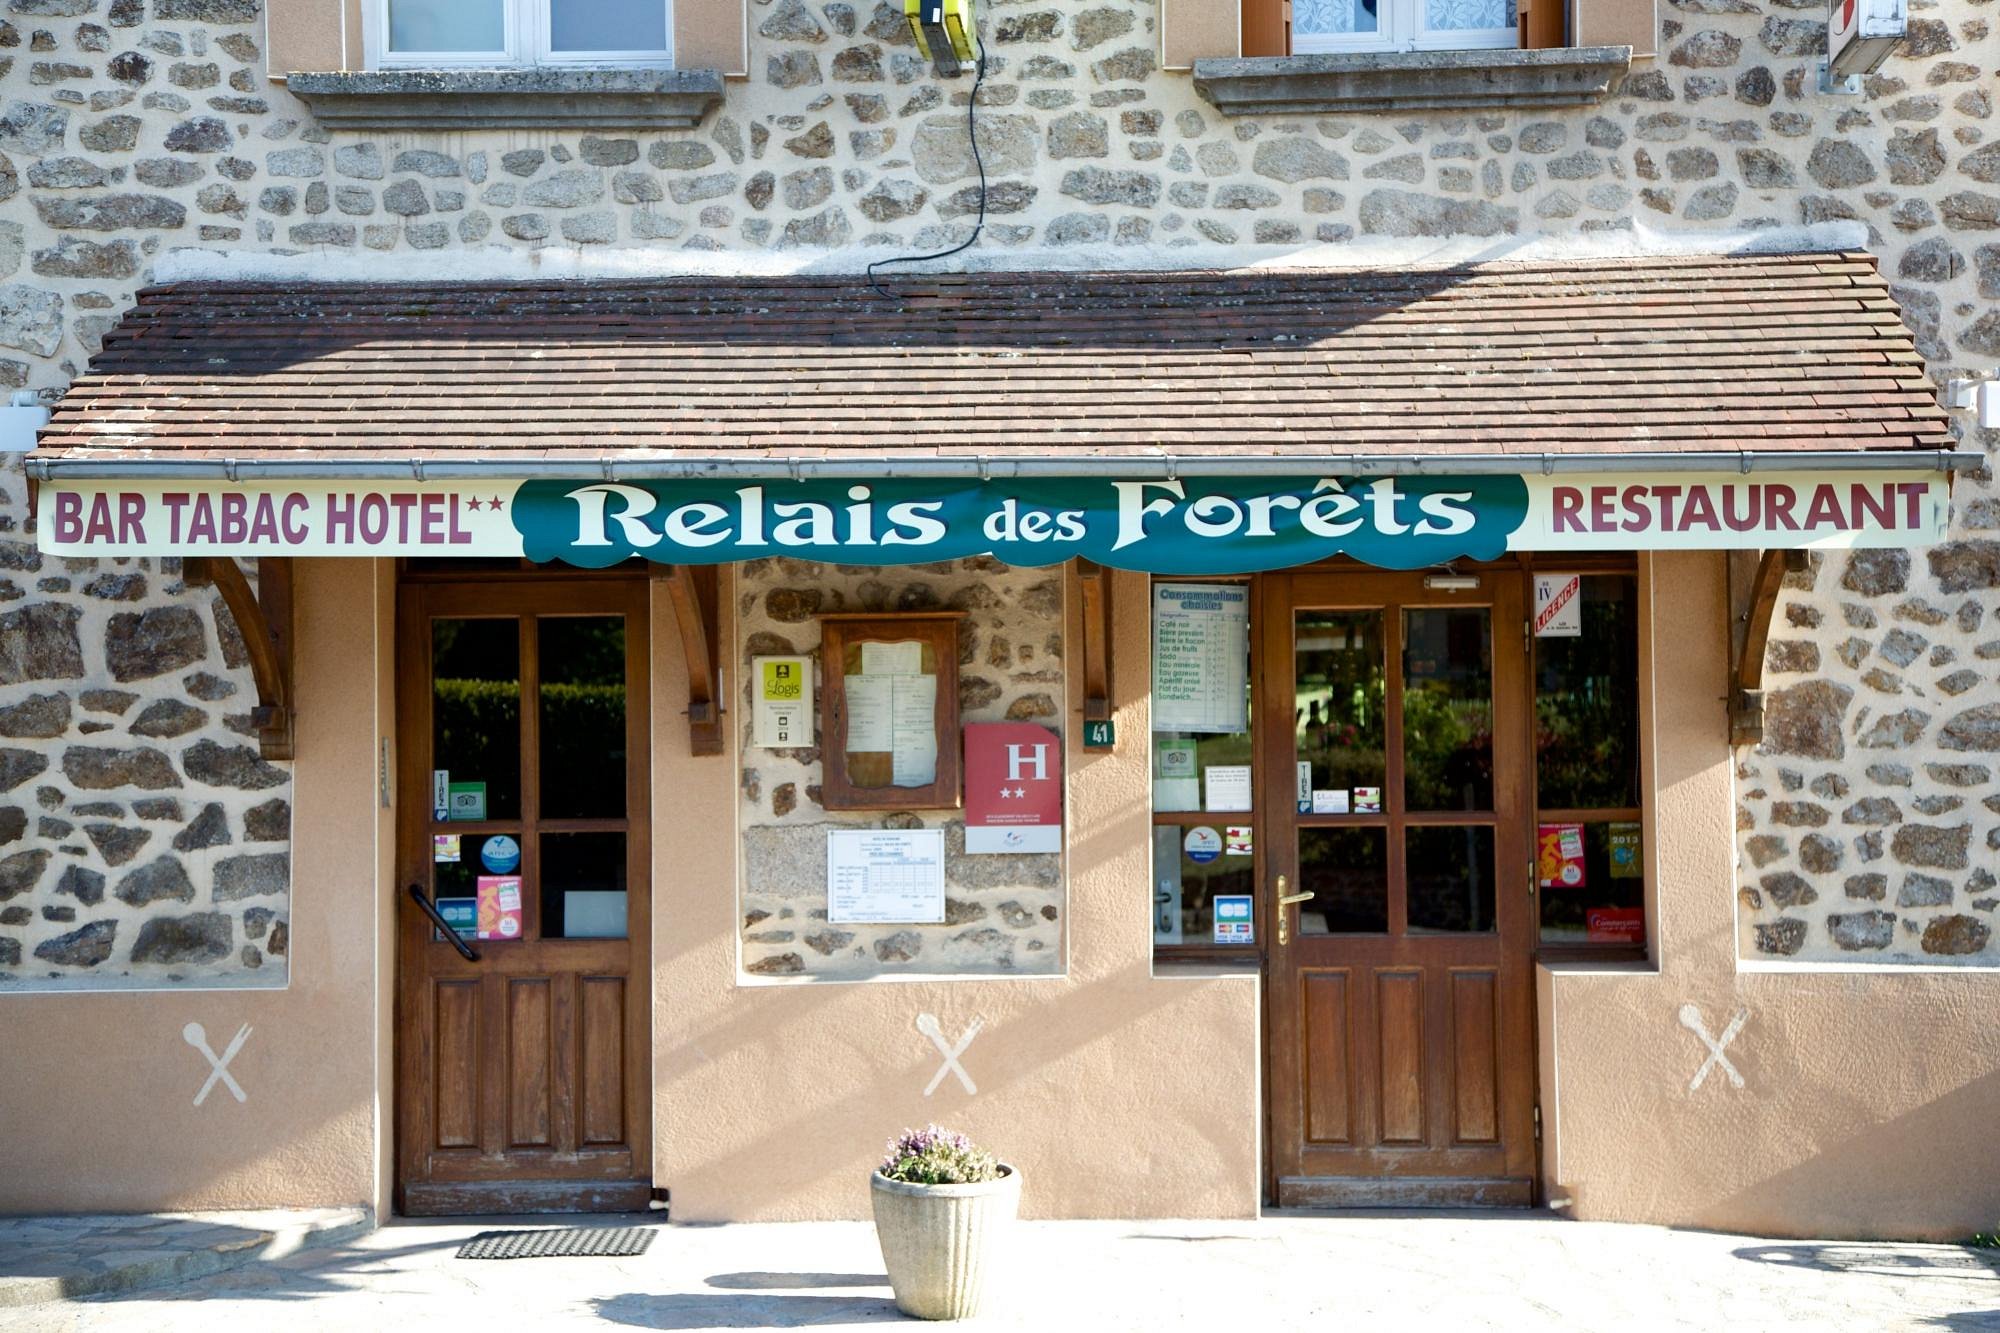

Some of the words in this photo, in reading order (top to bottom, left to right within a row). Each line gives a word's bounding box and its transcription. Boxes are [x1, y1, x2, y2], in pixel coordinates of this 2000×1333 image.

[56, 492, 147, 543] BAR
[163, 492, 309, 544] TABAC
[327, 492, 472, 544] HOTEL
[564, 484, 946, 547] Relais
[984, 498, 1086, 541] des
[1111, 478, 1476, 551] Forêts
[1553, 482, 1929, 532] RESTAURANT
[1536, 577, 1578, 632] LICENCE
[1539, 588, 1551, 600] IV
[1159, 620, 1176, 628] Café
[1092, 723, 1108, 743] 41
[1005, 744, 1050, 780] H
